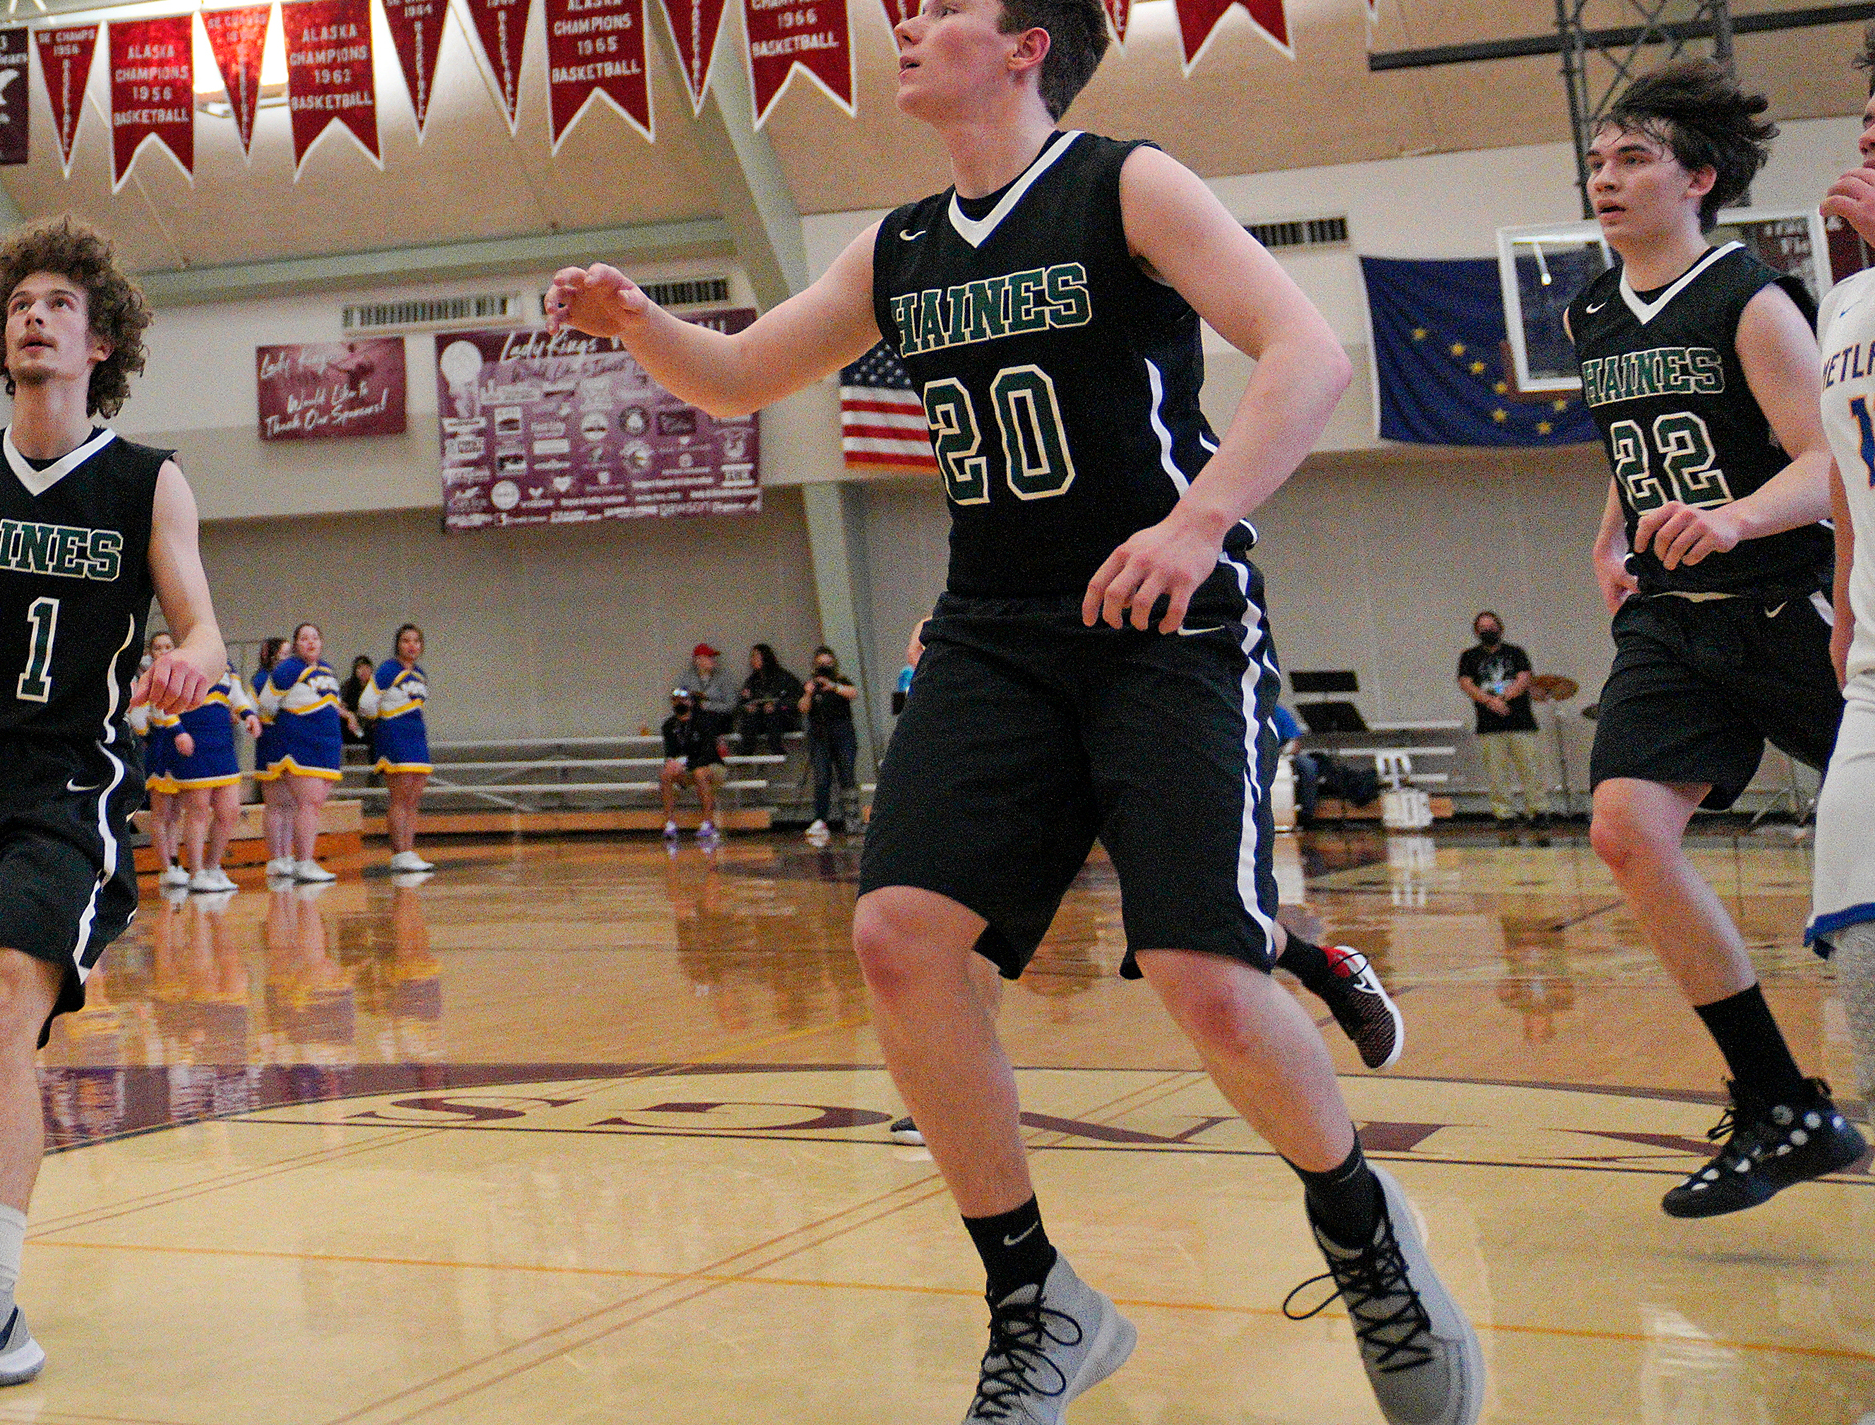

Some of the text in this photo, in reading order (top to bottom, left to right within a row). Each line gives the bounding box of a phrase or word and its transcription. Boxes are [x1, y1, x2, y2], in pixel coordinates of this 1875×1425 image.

[554, 12, 632, 36] CHAMPIONS
[777, 7, 817, 29] 1966
[302, 23, 358, 43] ALASKA
[752, 30, 839, 57] BASKETBALL
[127, 45, 175, 60] ALASKA
[289, 45, 368, 67] CHAMPIONS
[577, 36, 618, 56] 1965
[114, 66, 189, 83] CHAMPIONS
[552, 59, 642, 84] BASKETBALL
[132, 86, 173, 102] 1956
[291, 90, 373, 111] BASKETBALL
[114, 108, 190, 126] BASKETBALL
[890, 261, 1092, 358] HAINES
[501, 330, 544, 365] Lady
[1581, 346, 1725, 408] HAINES
[923, 363, 1076, 506] 20
[1609, 411, 1735, 516] 22
